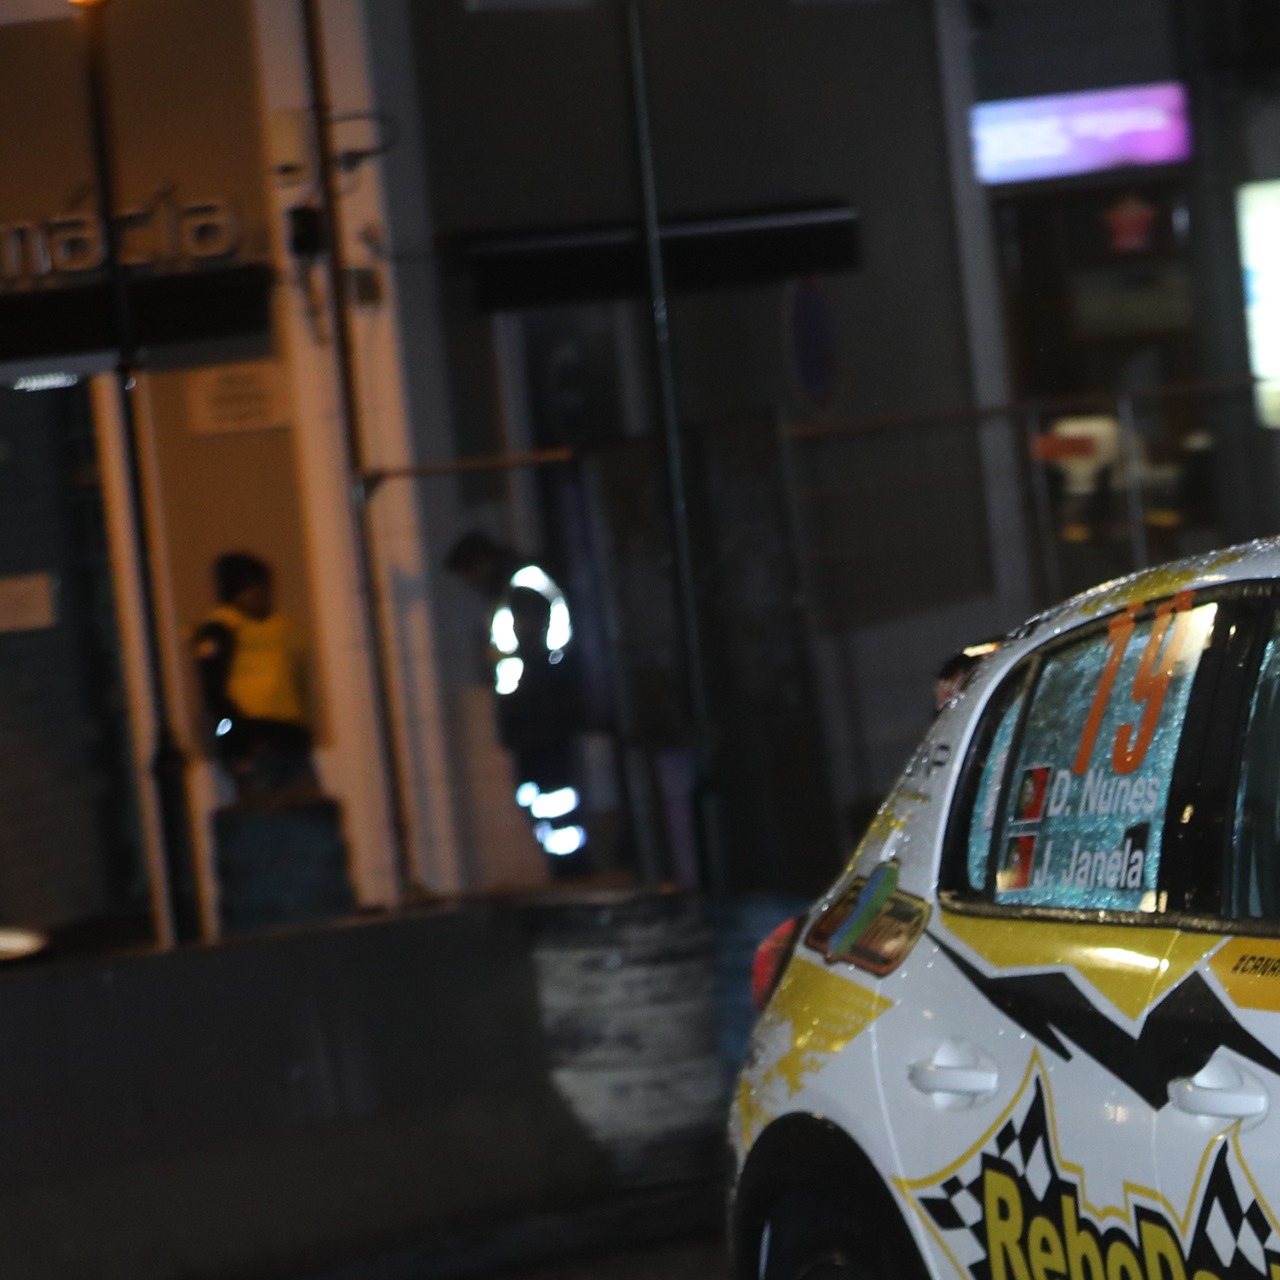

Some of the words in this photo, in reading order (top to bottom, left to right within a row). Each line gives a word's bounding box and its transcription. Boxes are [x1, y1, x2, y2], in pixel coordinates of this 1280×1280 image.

[1072, 591, 1194, 775] 19
[1049, 769, 1072, 817] D.
[1078, 768, 1161, 817] Nunes
[1034, 840, 1055, 887] J.
[1062, 838, 1146, 889] Janela
